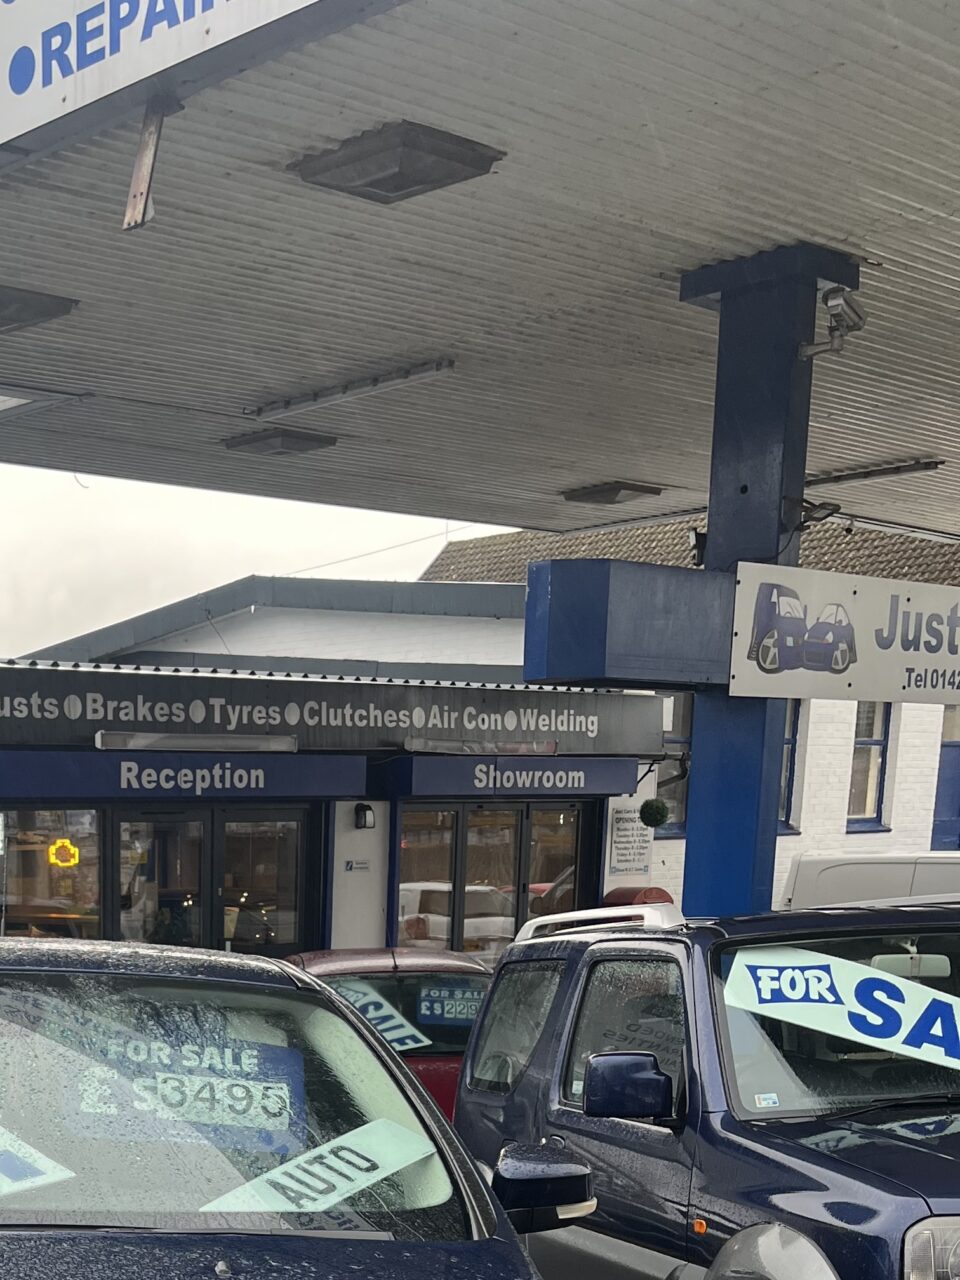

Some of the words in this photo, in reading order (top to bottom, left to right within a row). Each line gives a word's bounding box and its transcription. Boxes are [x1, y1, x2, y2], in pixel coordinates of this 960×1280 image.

[874, 594, 960, 655] Just
[905, 667, 928, 689] Tel
[86, 692, 185, 722] Brakes
[209, 697, 280, 732] Tyres
[302, 700, 411, 729] Clutches
[428, 704, 458, 729] Air
[463, 705, 502, 731] Con
[518, 708, 599, 738] Welding
[119, 761, 265, 795] Reception
[473, 764, 586, 789] Showroom
[421, 988, 450, 997] FOR
[756, 968, 836, 1003] FOR
[107, 1039, 172, 1065] FOR
[181, 1045, 259, 1073] SALE
[265, 1145, 380, 1209] AUTO
